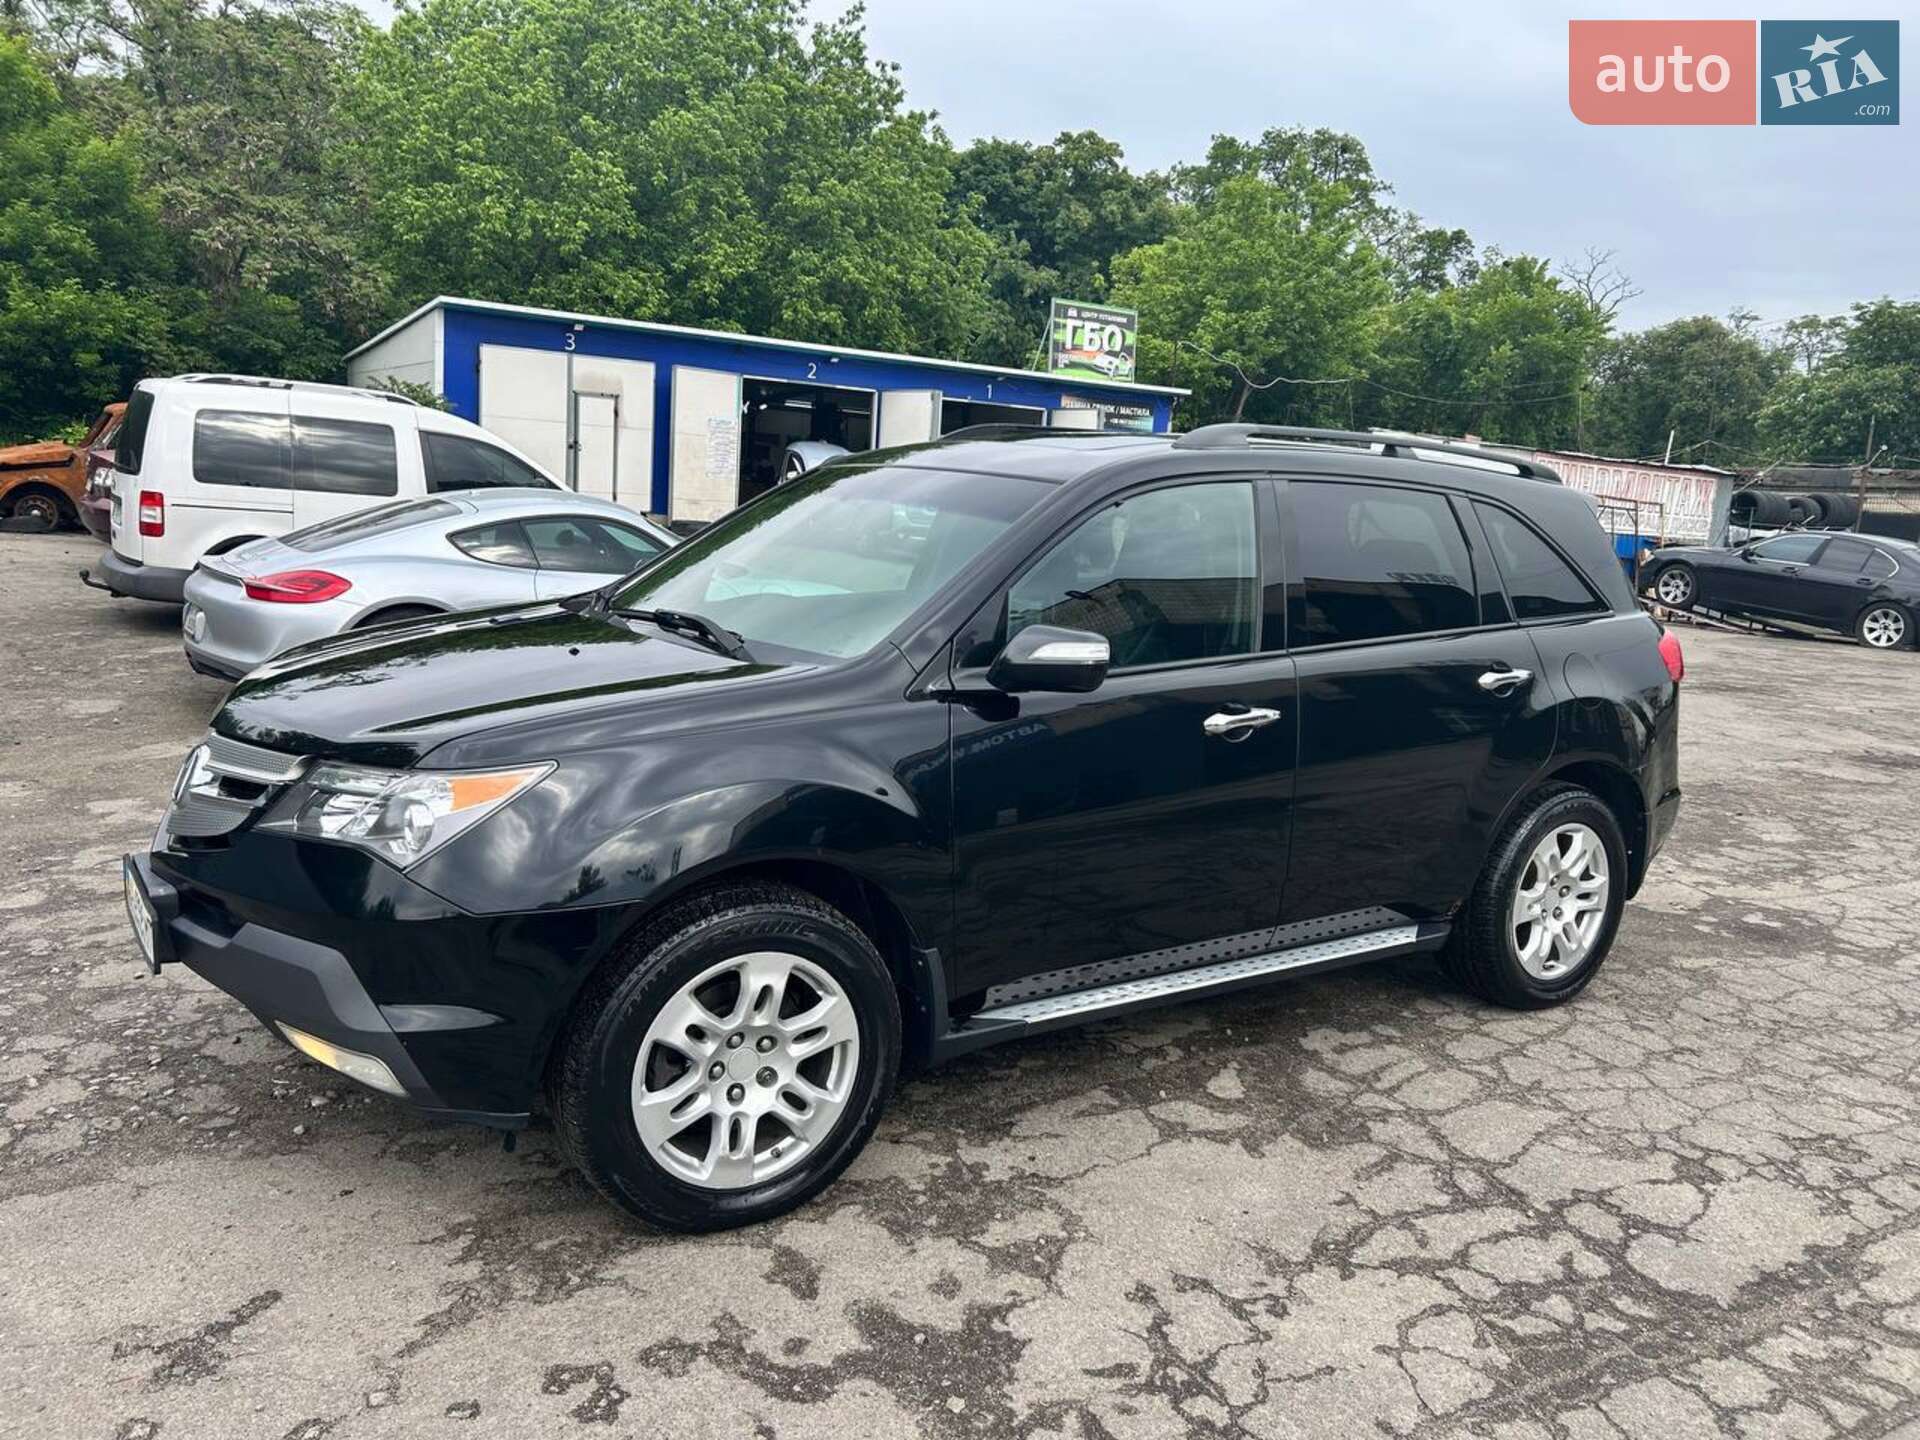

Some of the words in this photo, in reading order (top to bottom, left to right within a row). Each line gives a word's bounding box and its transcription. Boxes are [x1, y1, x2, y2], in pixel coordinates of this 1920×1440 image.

[564, 333, 576, 351] 3
[1065, 318, 1122, 352] ГБО
[808, 363, 817, 379] 2
[986, 384, 993, 399] 1
